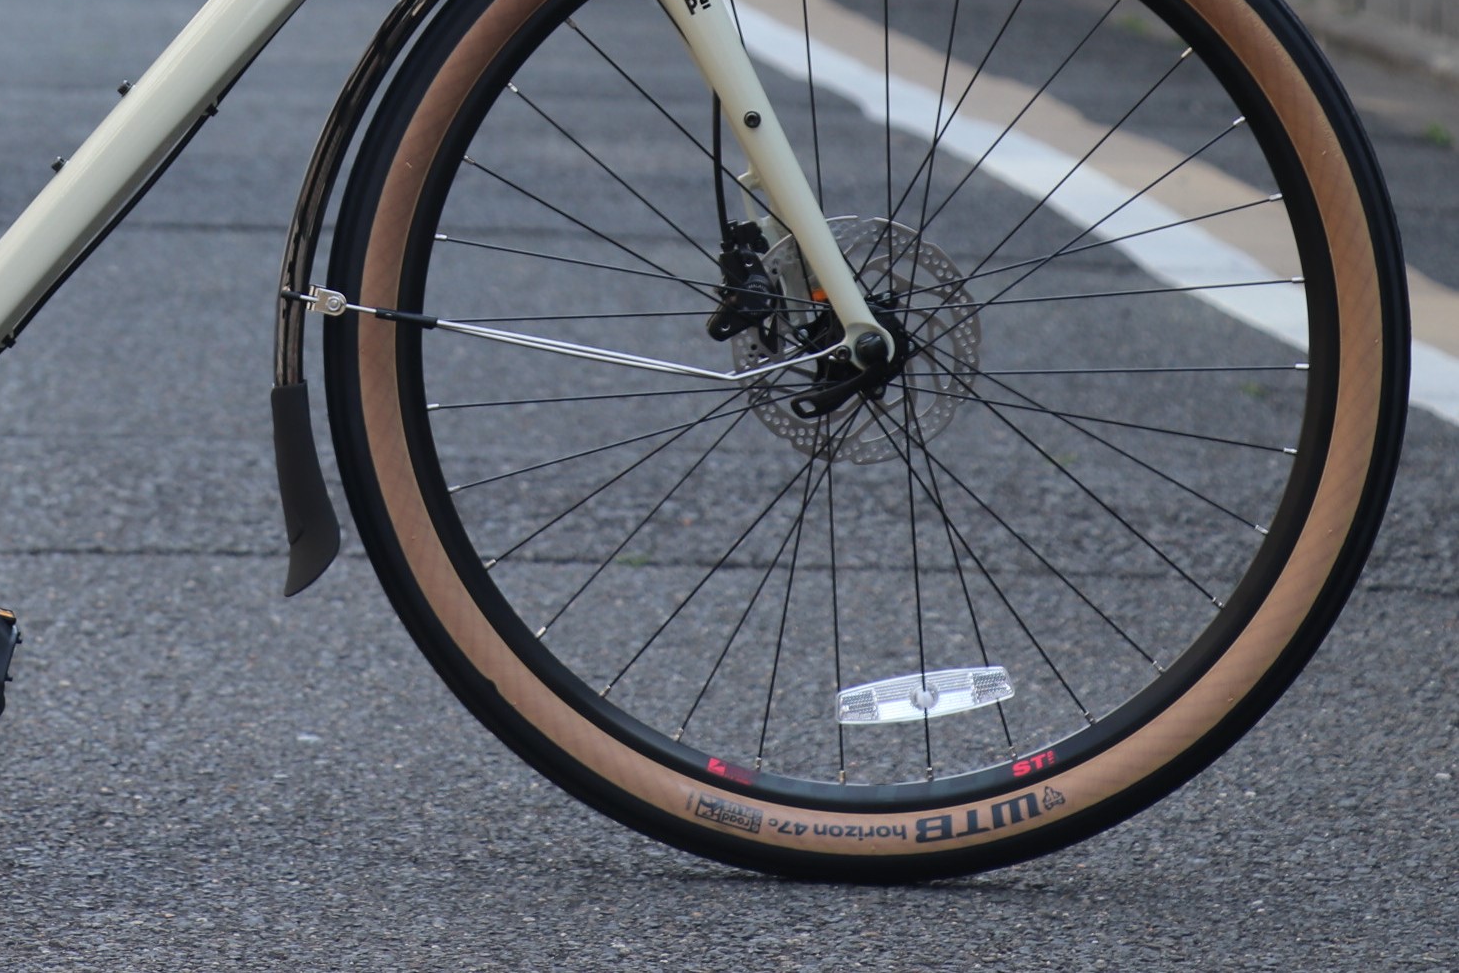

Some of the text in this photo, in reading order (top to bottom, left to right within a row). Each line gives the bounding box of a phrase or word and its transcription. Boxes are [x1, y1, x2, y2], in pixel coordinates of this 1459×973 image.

[769, 792, 1042, 843] WTB horizon 47c
